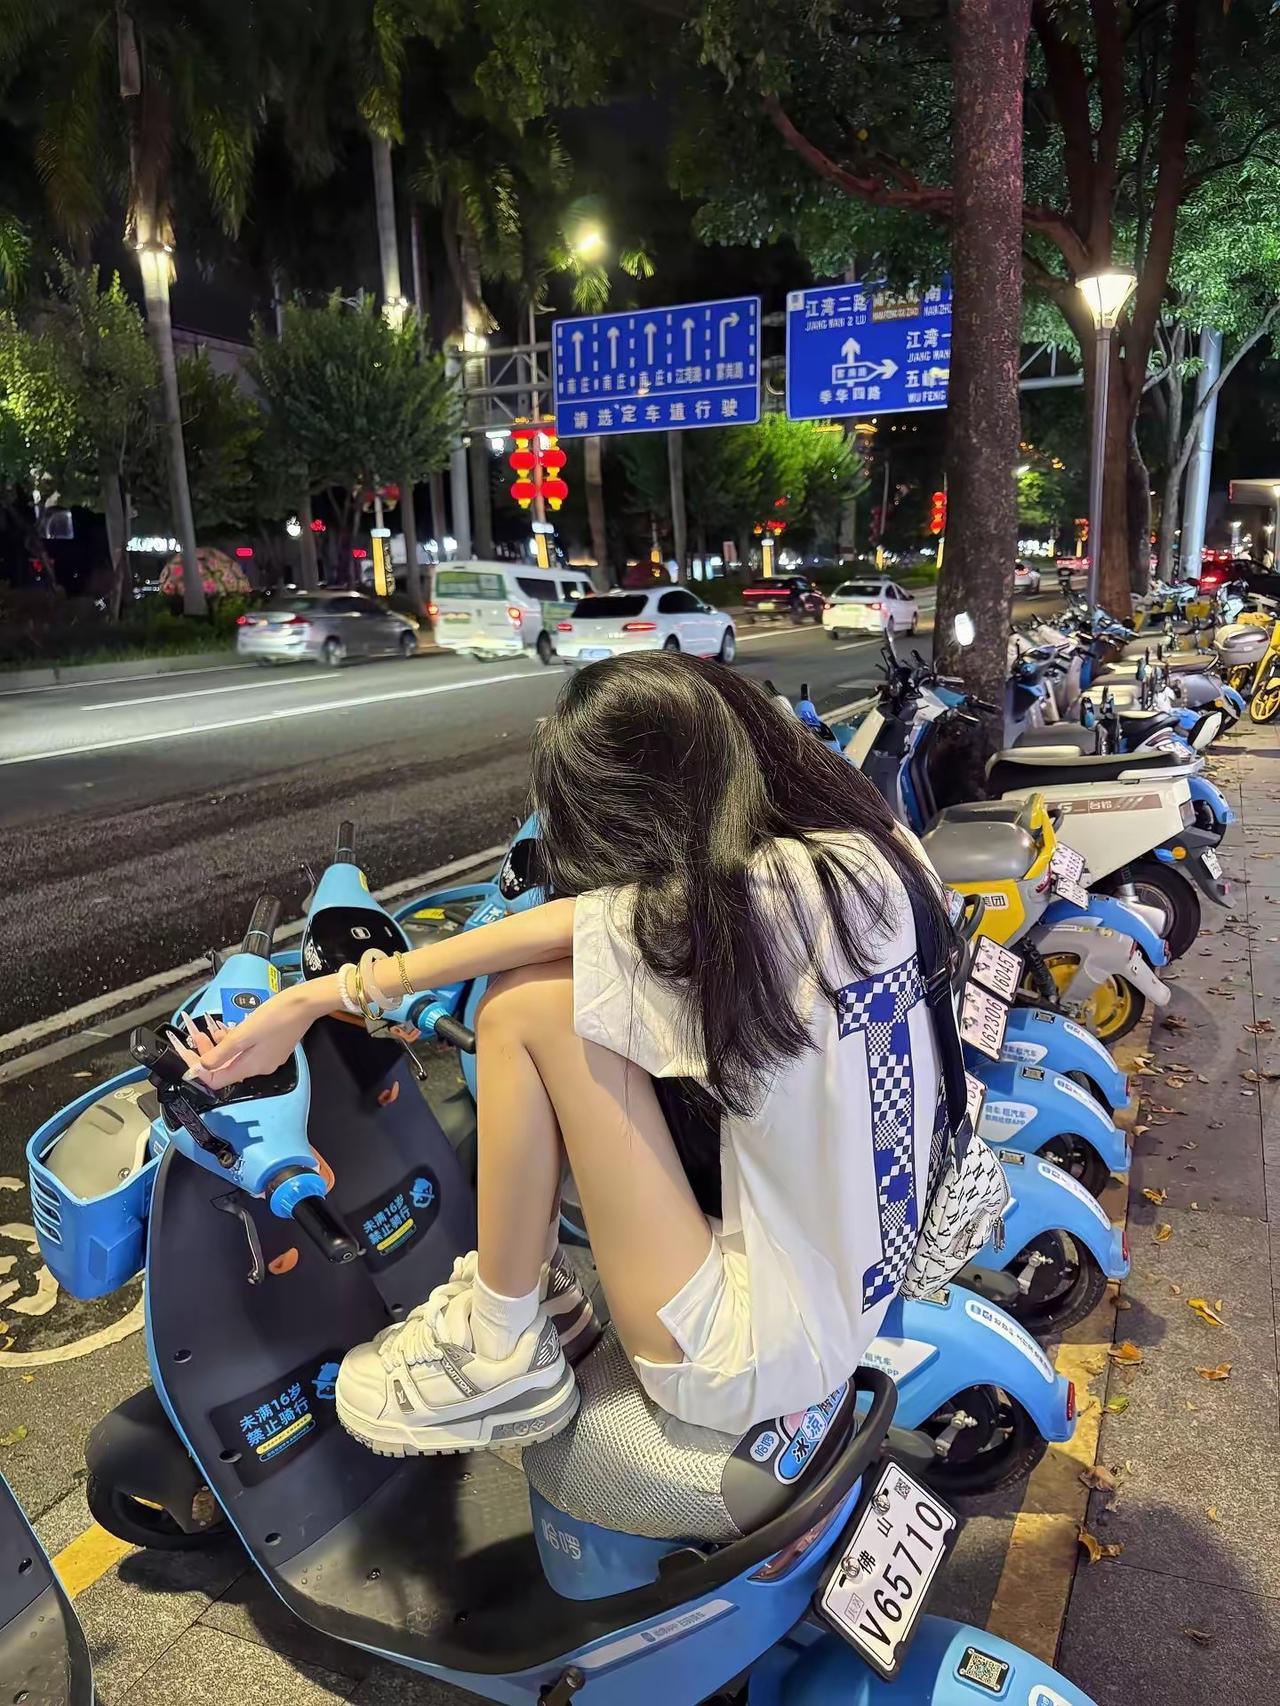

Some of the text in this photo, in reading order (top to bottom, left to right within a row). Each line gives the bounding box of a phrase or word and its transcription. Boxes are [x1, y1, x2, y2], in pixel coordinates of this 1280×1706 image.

[805, 294, 868, 318] 江湾二路
[847, 317, 853, 327] 2
[855, 315, 866, 325] LU
[907, 352, 931, 363] JIANG
[574, 398, 738, 429] 请选定车道行驶
[979, 998, 1003, 1051] V62306
[362, 1194, 405, 1233] 未满16岁
[239, 1382, 301, 1431] 未满16岁
[246, 1397, 310, 1446] 禁止骑行
[859, 1501, 943, 1646] V65710
